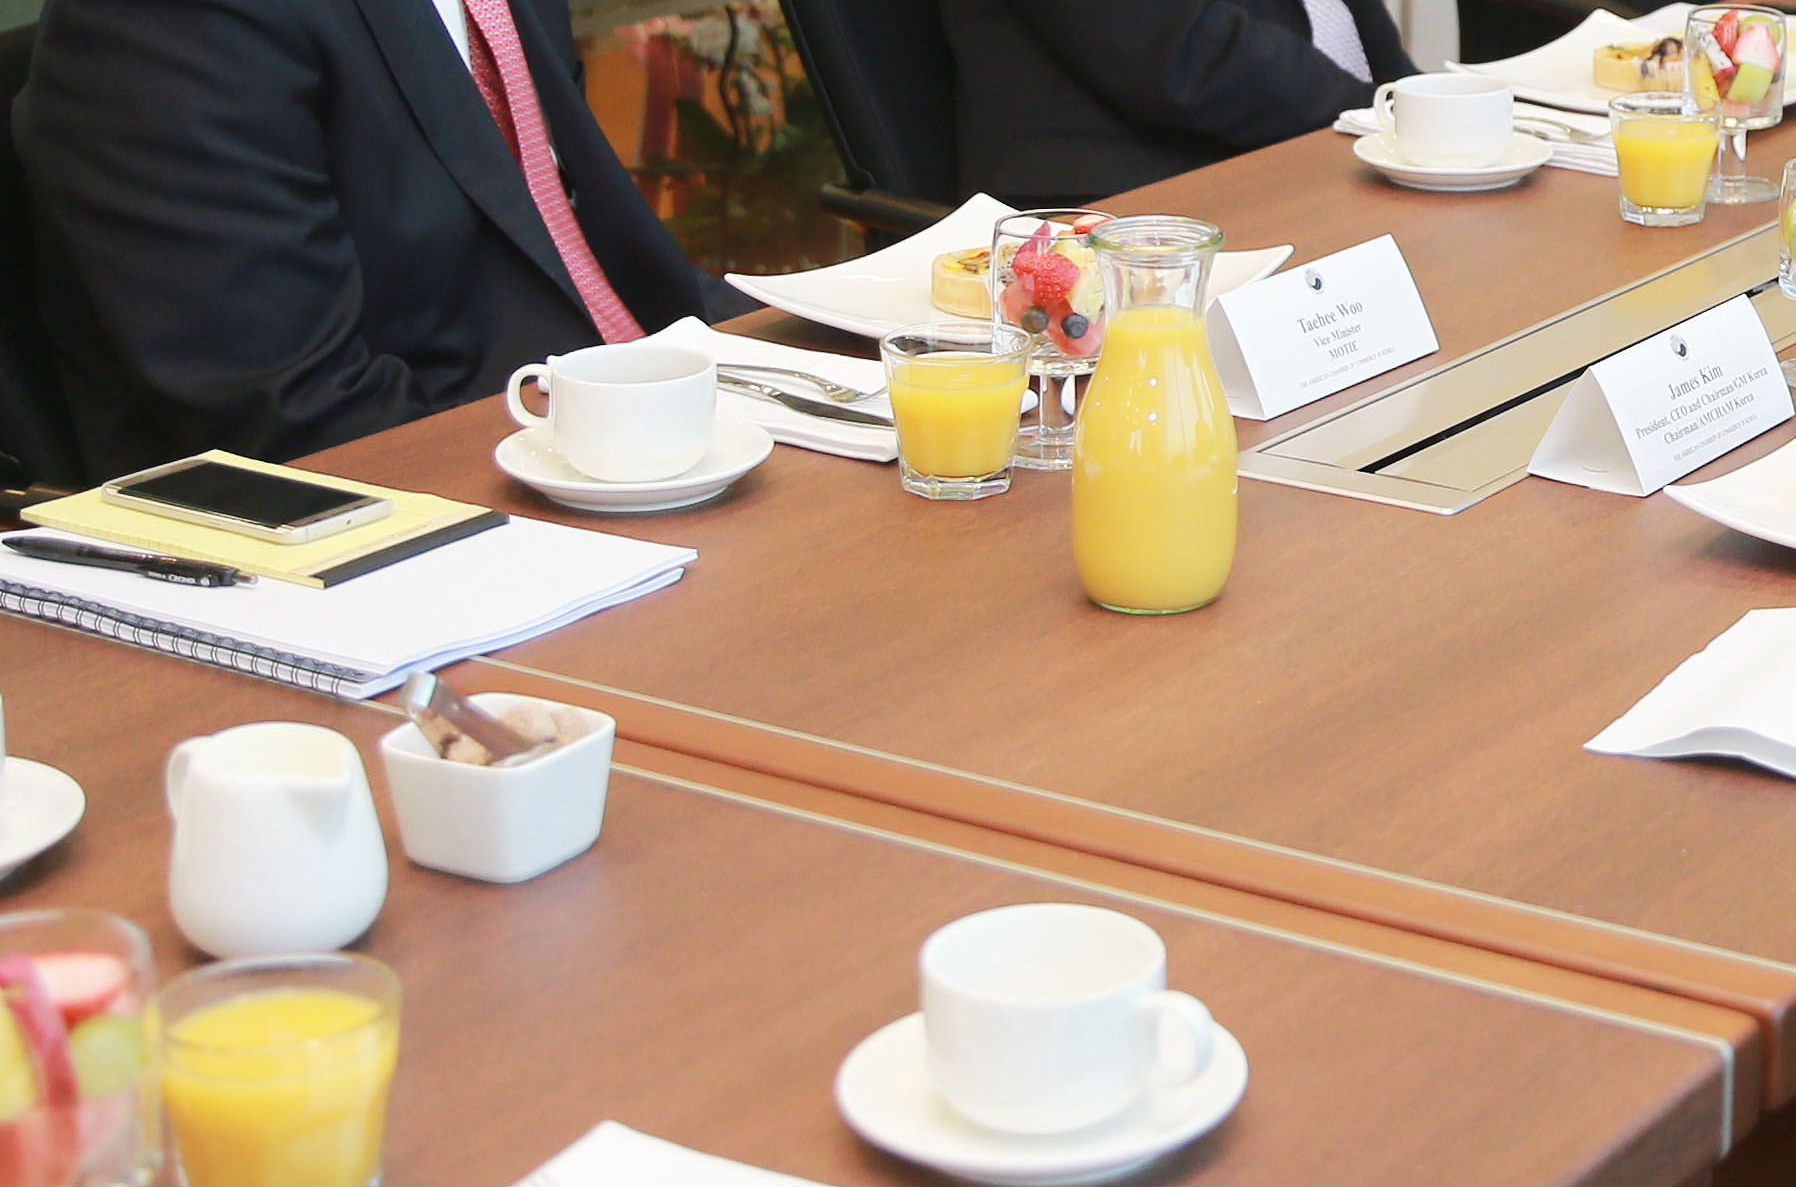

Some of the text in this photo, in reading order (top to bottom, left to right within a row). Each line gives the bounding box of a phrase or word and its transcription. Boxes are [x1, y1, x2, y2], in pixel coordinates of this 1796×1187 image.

[1297, 301, 1364, 334] Taehee Woo
[1313, 324, 1362, 347] Vice Minister
[1328, 340, 1359, 360] MOTIE
[1668, 364, 1723, 400] James Kim
[1670, 405, 1688, 422] CEO
